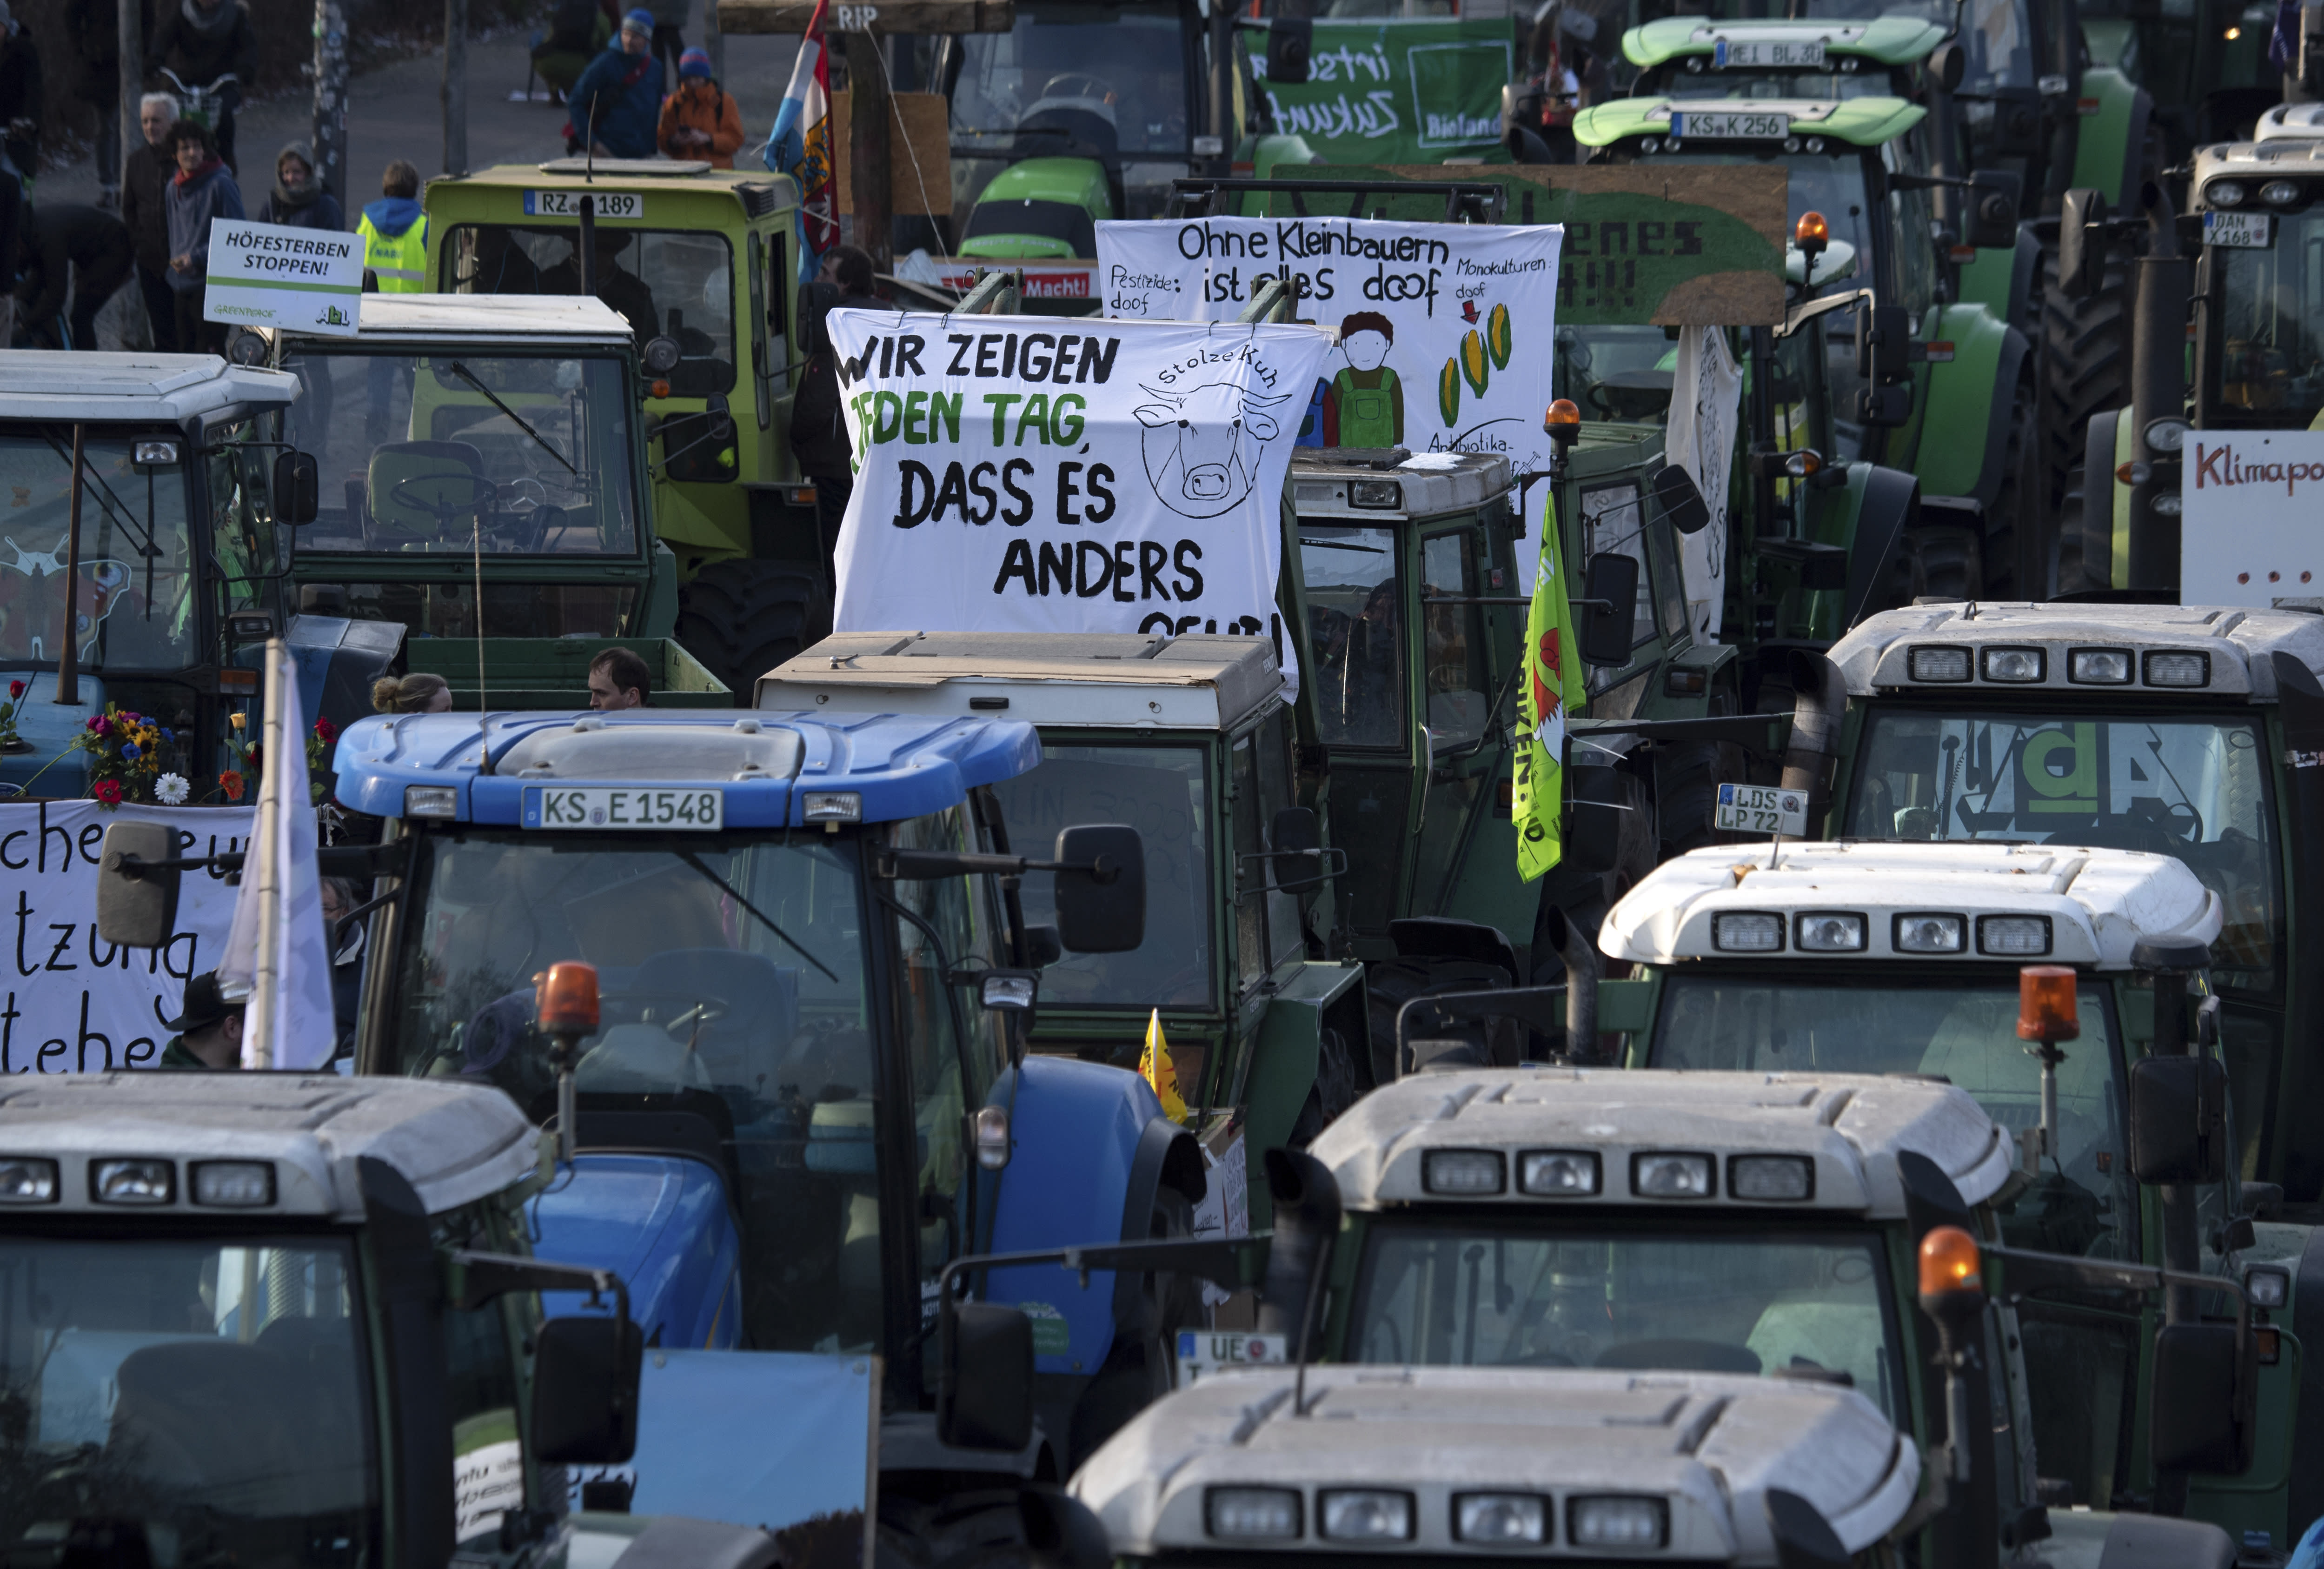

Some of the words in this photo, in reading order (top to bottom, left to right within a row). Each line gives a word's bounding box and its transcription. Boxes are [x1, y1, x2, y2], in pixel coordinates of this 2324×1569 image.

[838, 5, 877, 31] RIP
[1689, 116, 1713, 134] KS
[1727, 117, 1740, 134] K
[1744, 117, 1780, 135] 256
[543, 193, 568, 213] RZ
[598, 195, 634, 215] 189
[2216, 215, 2246, 228] DAN
[226, 231, 350, 258] HÖFESTERBEN
[1178, 222, 1268, 260] Ohne
[1276, 221, 1449, 265] Kleinbauern
[2210, 227, 2221, 244] X
[2222, 230, 2251, 245] 168
[244, 254, 329, 276] STOPPEN!
[1456, 257, 1552, 277] Monokulturen:
[1025, 277, 1087, 298] Macht!
[1111, 265, 1181, 293] Pestizide:
[1204, 267, 1245, 303] ist
[1363, 263, 1442, 318] doof
[1455, 282, 1486, 299] doof
[213, 304, 277, 318] GREENPEACE
[1111, 291, 1150, 314] doof
[831, 333, 926, 391] WIR
[945, 333, 1121, 385] ZEIGEN
[1158, 349, 1234, 384] Stolze
[892, 458, 1035, 529] DASS
[1056, 461, 1116, 525] ES
[993, 538, 1204, 603] ANDERS
[544, 792, 586, 823] KS
[609, 793, 628, 824] E
[636, 793, 716, 824] 1548
[1737, 788, 1777, 811] LDS
[1720, 807, 1748, 828] LP
[1754, 811, 1779, 831] 72
[0, 802, 104, 873] che
[1211, 1337, 1246, 1362] UE
[1188, 1363, 1203, 1380] T
